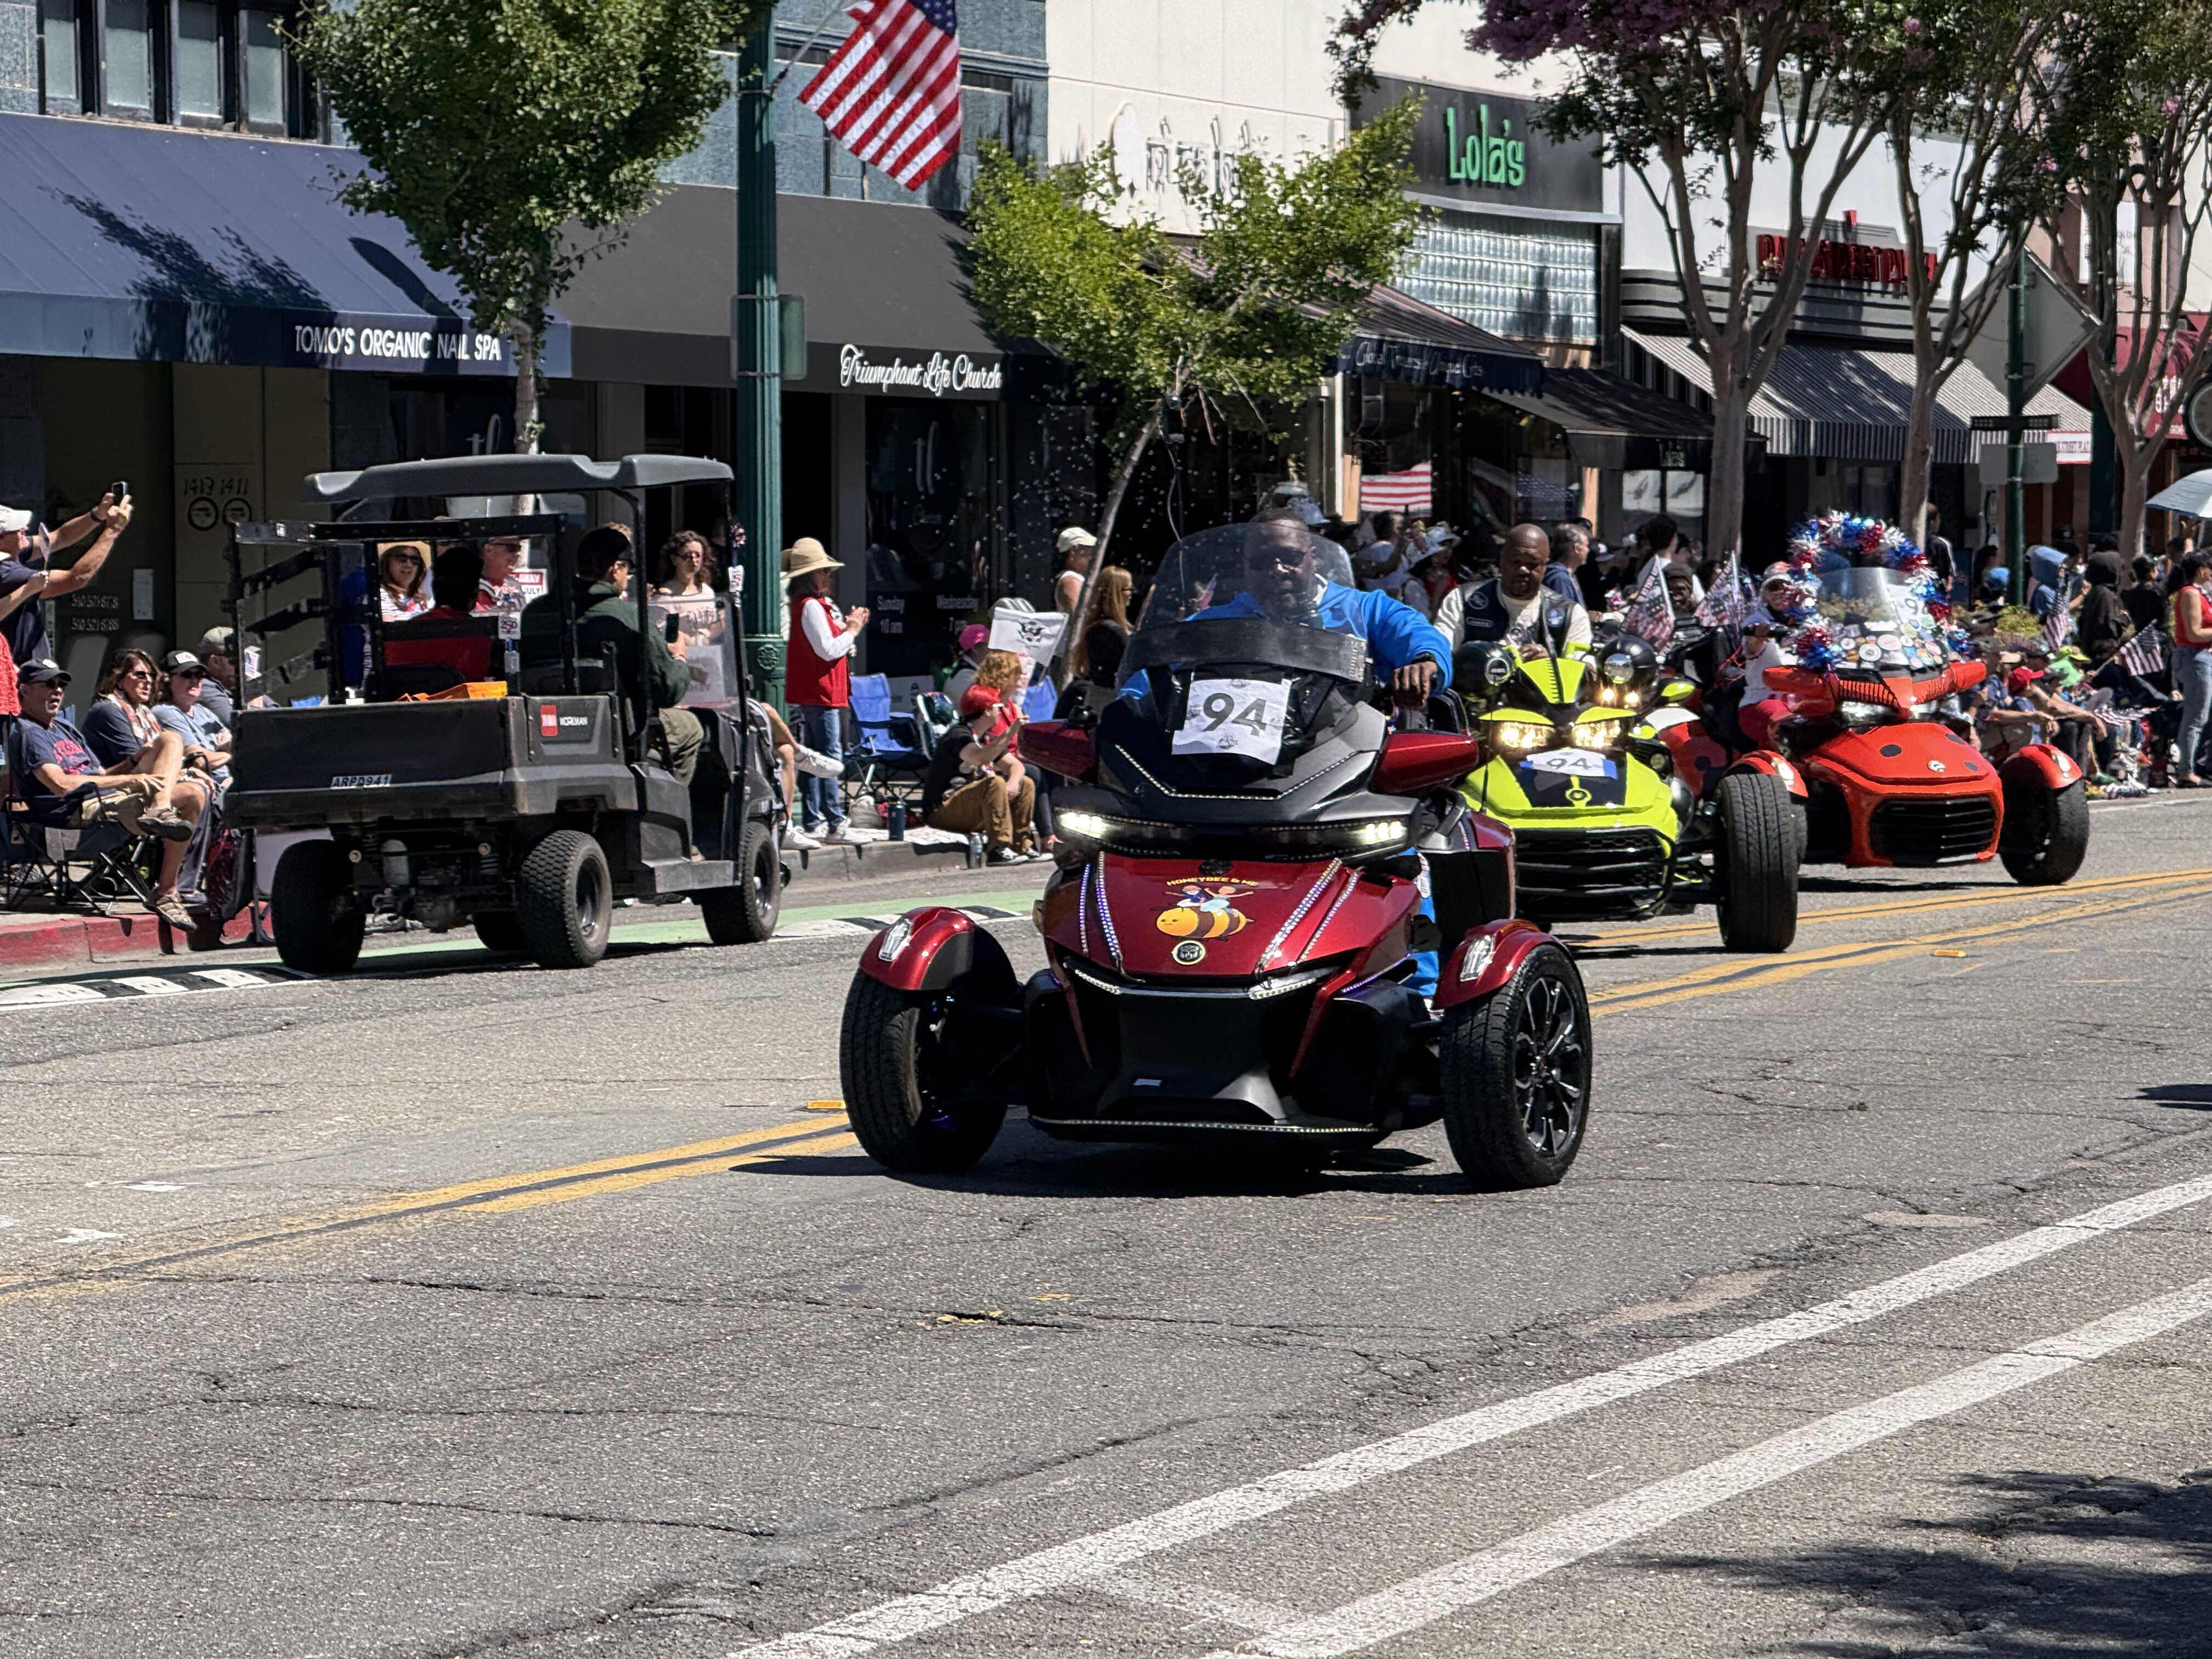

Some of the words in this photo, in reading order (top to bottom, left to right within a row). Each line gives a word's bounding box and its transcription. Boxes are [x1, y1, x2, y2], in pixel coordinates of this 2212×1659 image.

[1446, 104, 1526, 187] Lola's
[295, 325, 356, 356] TOMO'S
[359, 328, 432, 359] ORGANIC
[437, 332, 471, 360] NAIL
[474, 333, 502, 362] SPA
[840, 343, 924, 393] Triumphant
[923, 352, 951, 397] Life
[952, 354, 1003, 392] Church
[219, 477, 249, 495] 1411
[877, 595, 905, 614] Sunday
[935, 594, 979, 613] Wednesday
[879, 618, 890, 633] 10
[559, 716, 588, 726] WORKMAN
[1202, 692, 1267, 737] 94
[1546, 757, 1592, 770] 94
[332, 775, 390, 787] ARPD941
[1166, 877, 1229, 886] HONEYBEE
